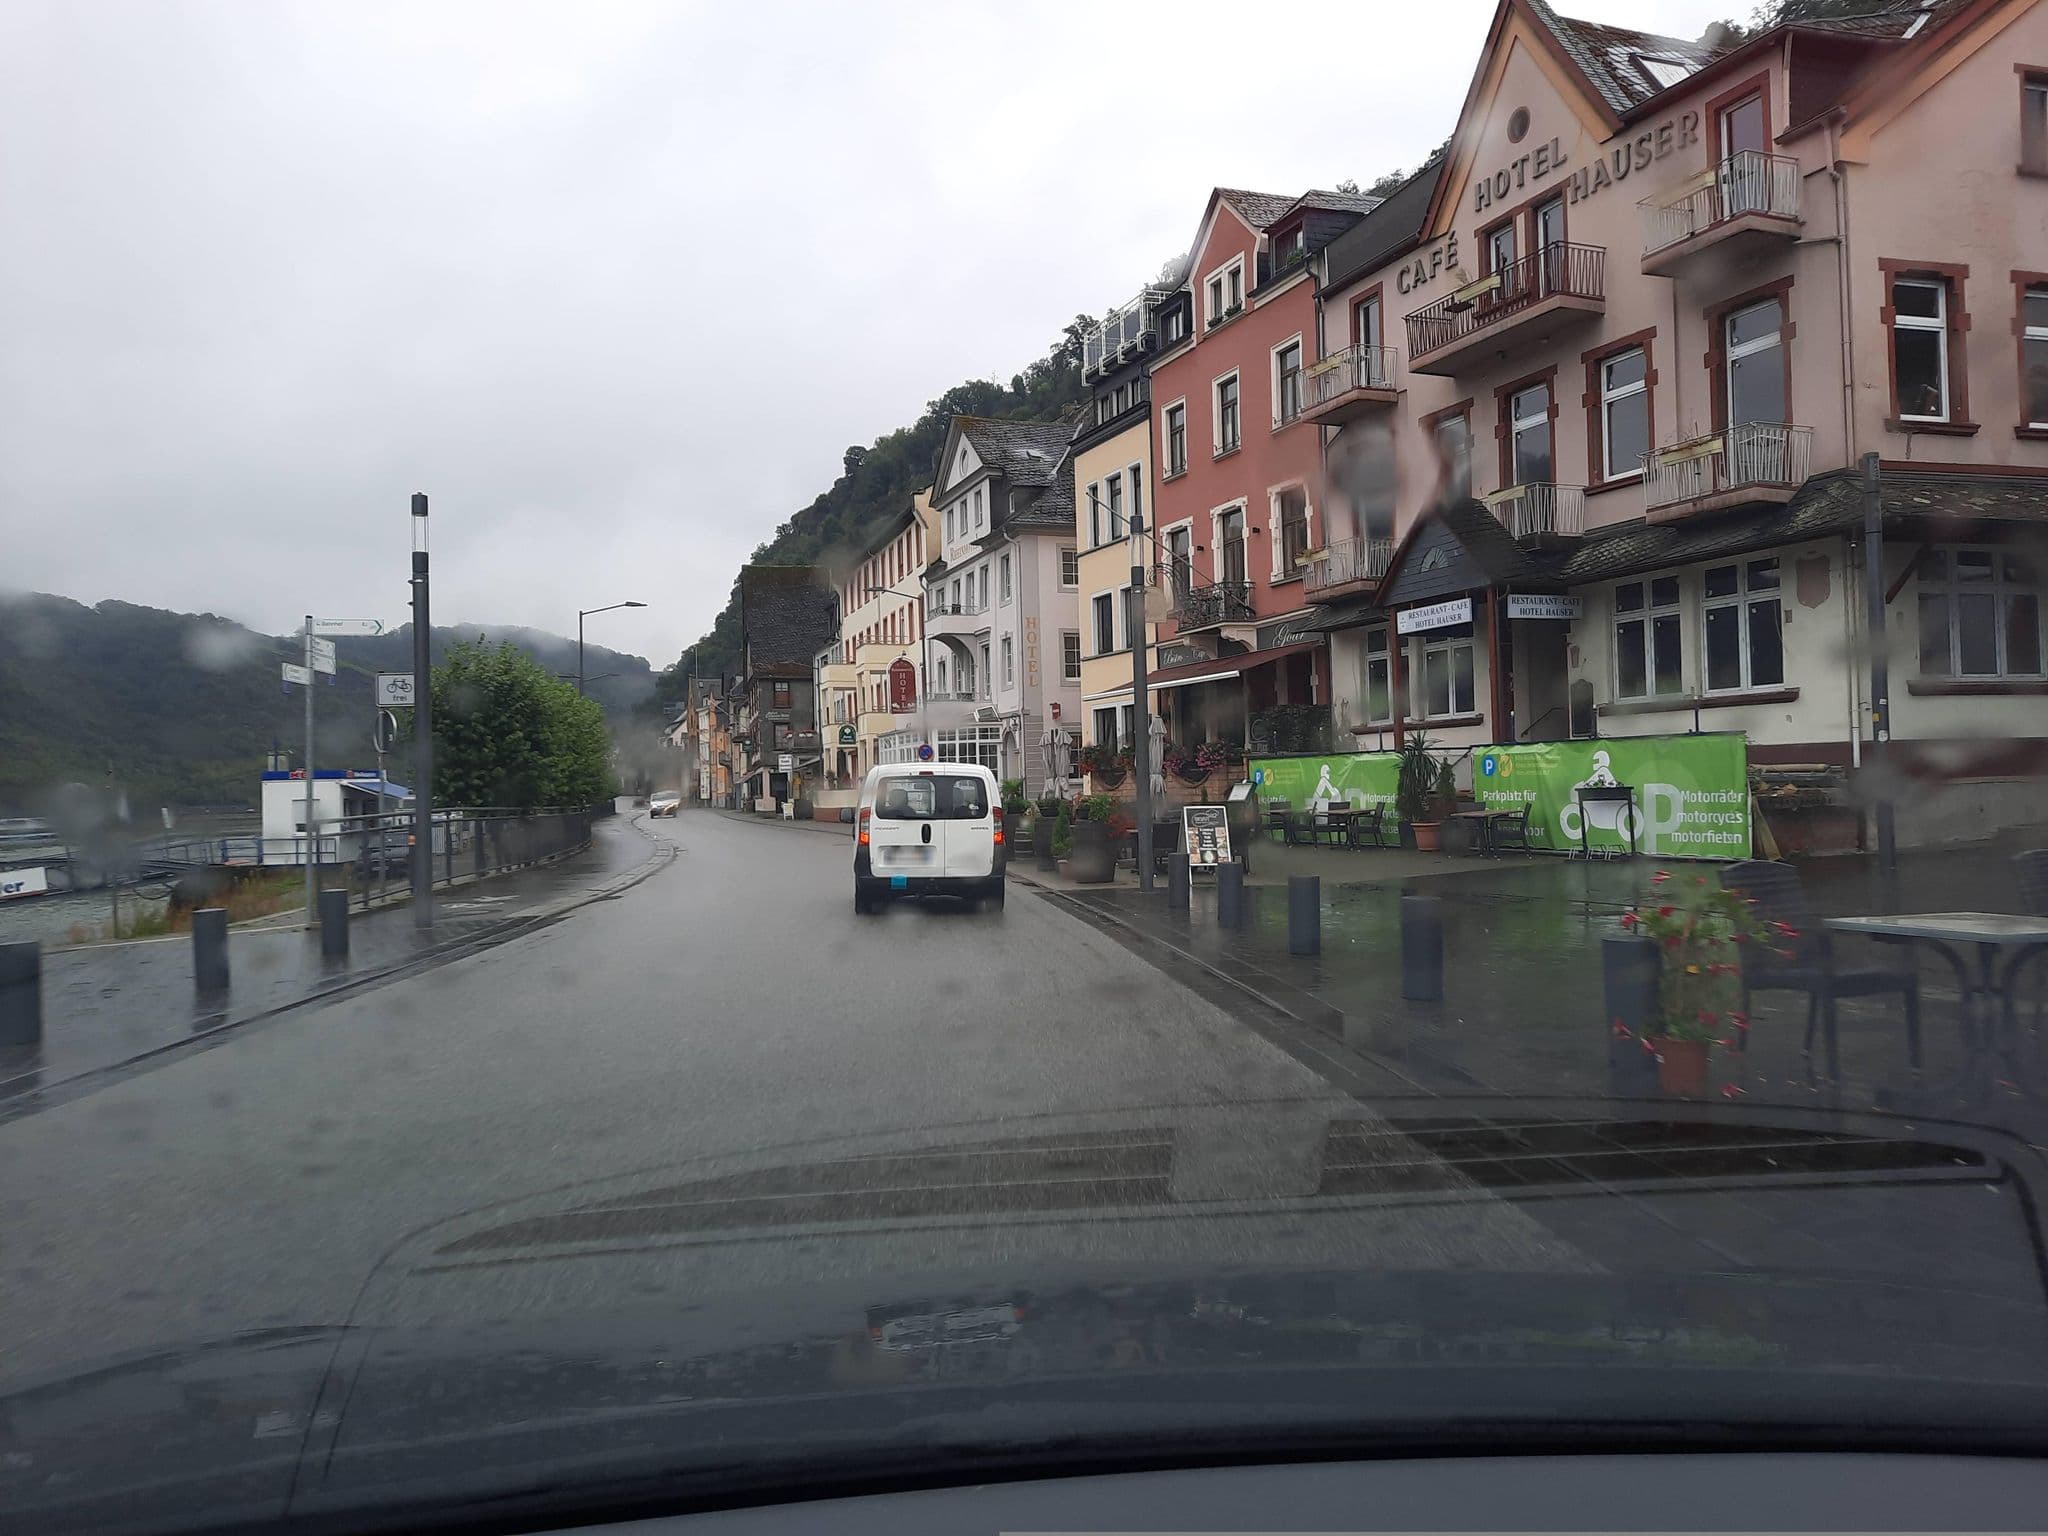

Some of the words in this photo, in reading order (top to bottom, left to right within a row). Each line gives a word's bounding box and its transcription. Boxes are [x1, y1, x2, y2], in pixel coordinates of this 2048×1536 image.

[1396, 230, 1459, 295] CAFÉ
[1474, 137, 1568, 212] HOTEL
[1569, 110, 1699, 205] HAUSER
[1519, 607, 1544, 616] HOTEL
[1545, 608, 1574, 617] HAUSER
[1415, 618, 1436, 629] HOTEL
[1437, 613, 1462, 625] HAUSER
[1025, 616, 1039, 687] HOTEL
[899, 672, 907, 709] HOTEL
[1485, 759, 1493, 774] P
[1482, 790, 1522, 804] Parkplatz
[1523, 790, 1537, 801] für
[1677, 811, 1744, 826] motorcyces
